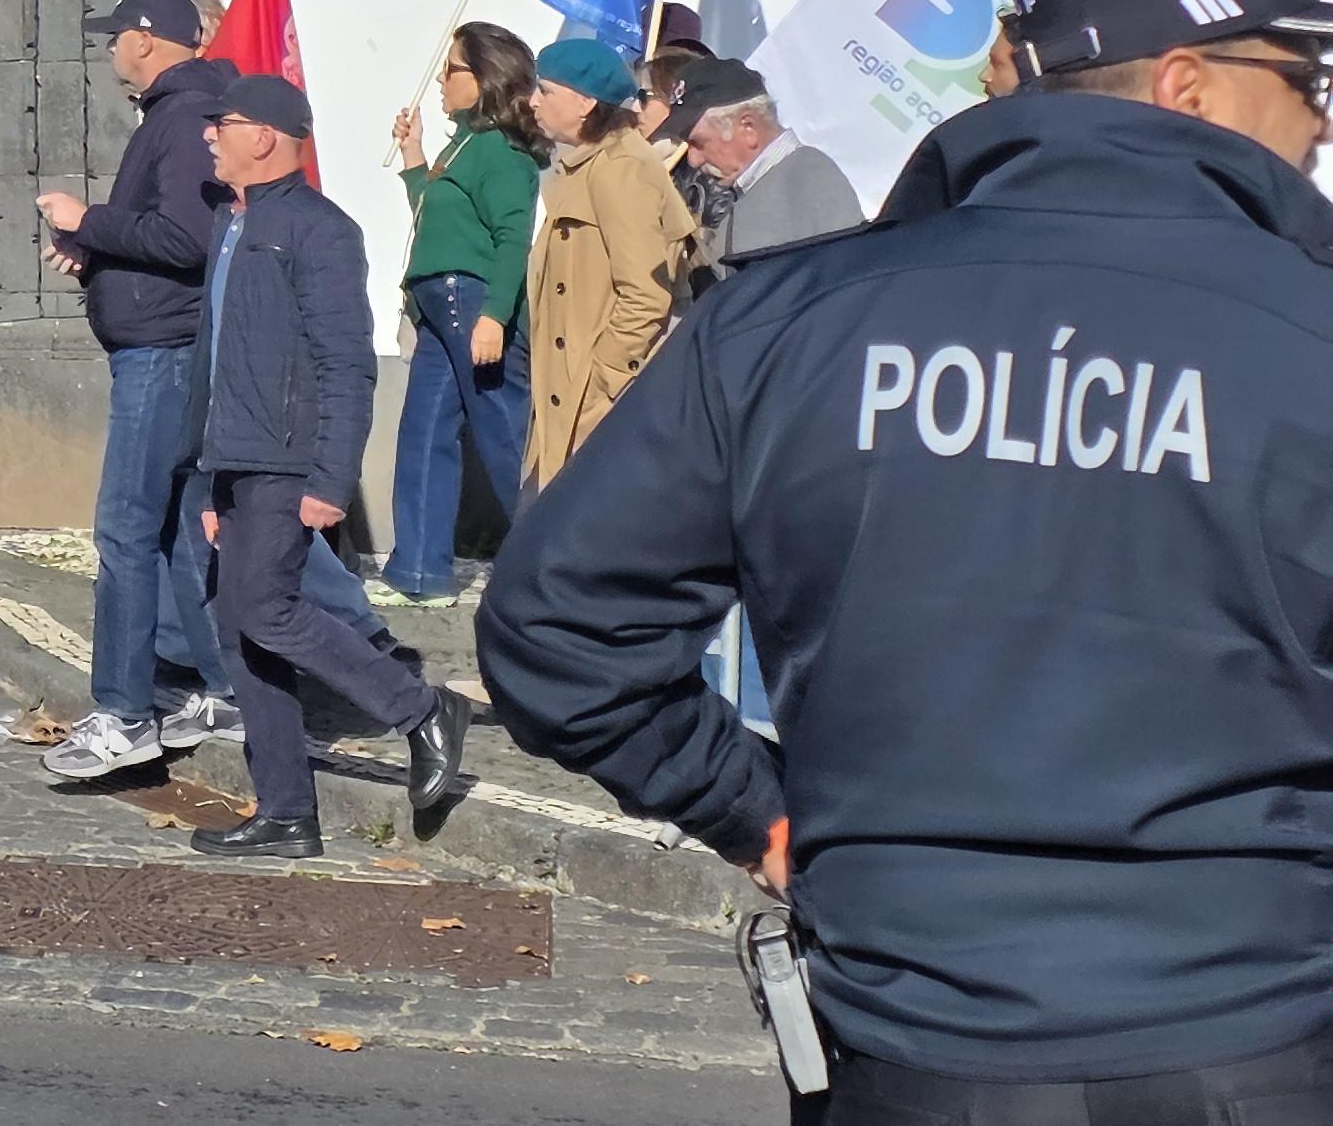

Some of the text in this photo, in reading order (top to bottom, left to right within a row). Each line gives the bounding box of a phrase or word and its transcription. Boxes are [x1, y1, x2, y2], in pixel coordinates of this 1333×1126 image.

[843, 39, 945, 126] região aço
[856, 326, 1211, 483] POLÍCIA
